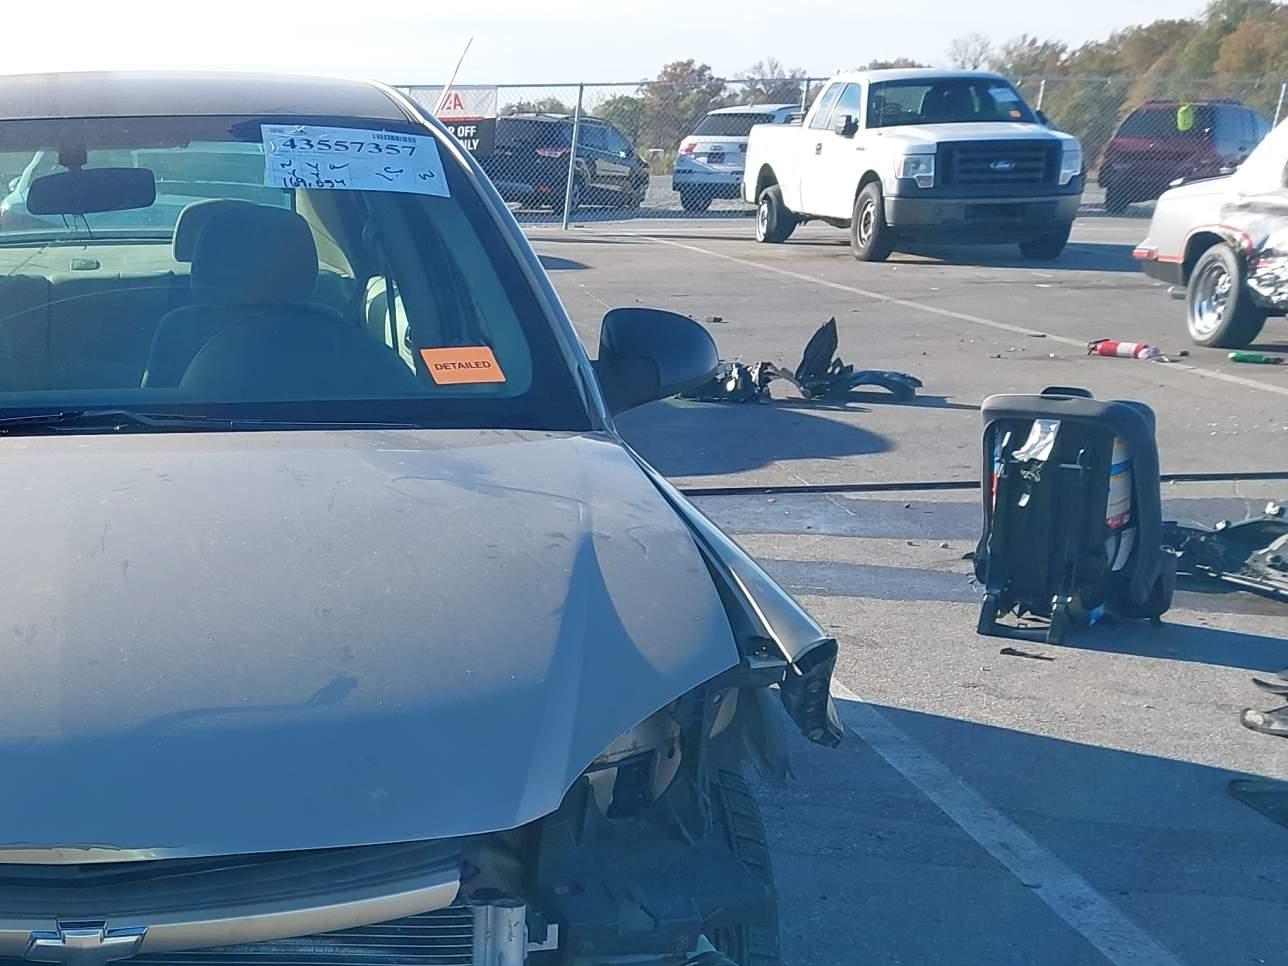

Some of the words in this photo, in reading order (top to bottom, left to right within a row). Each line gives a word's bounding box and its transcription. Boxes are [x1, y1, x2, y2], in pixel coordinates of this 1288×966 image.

[457, 125, 476, 137] OFF
[281, 138, 416, 157] 43557357
[460, 138, 479, 150] NLY
[433, 360, 491, 371] DETAILED
